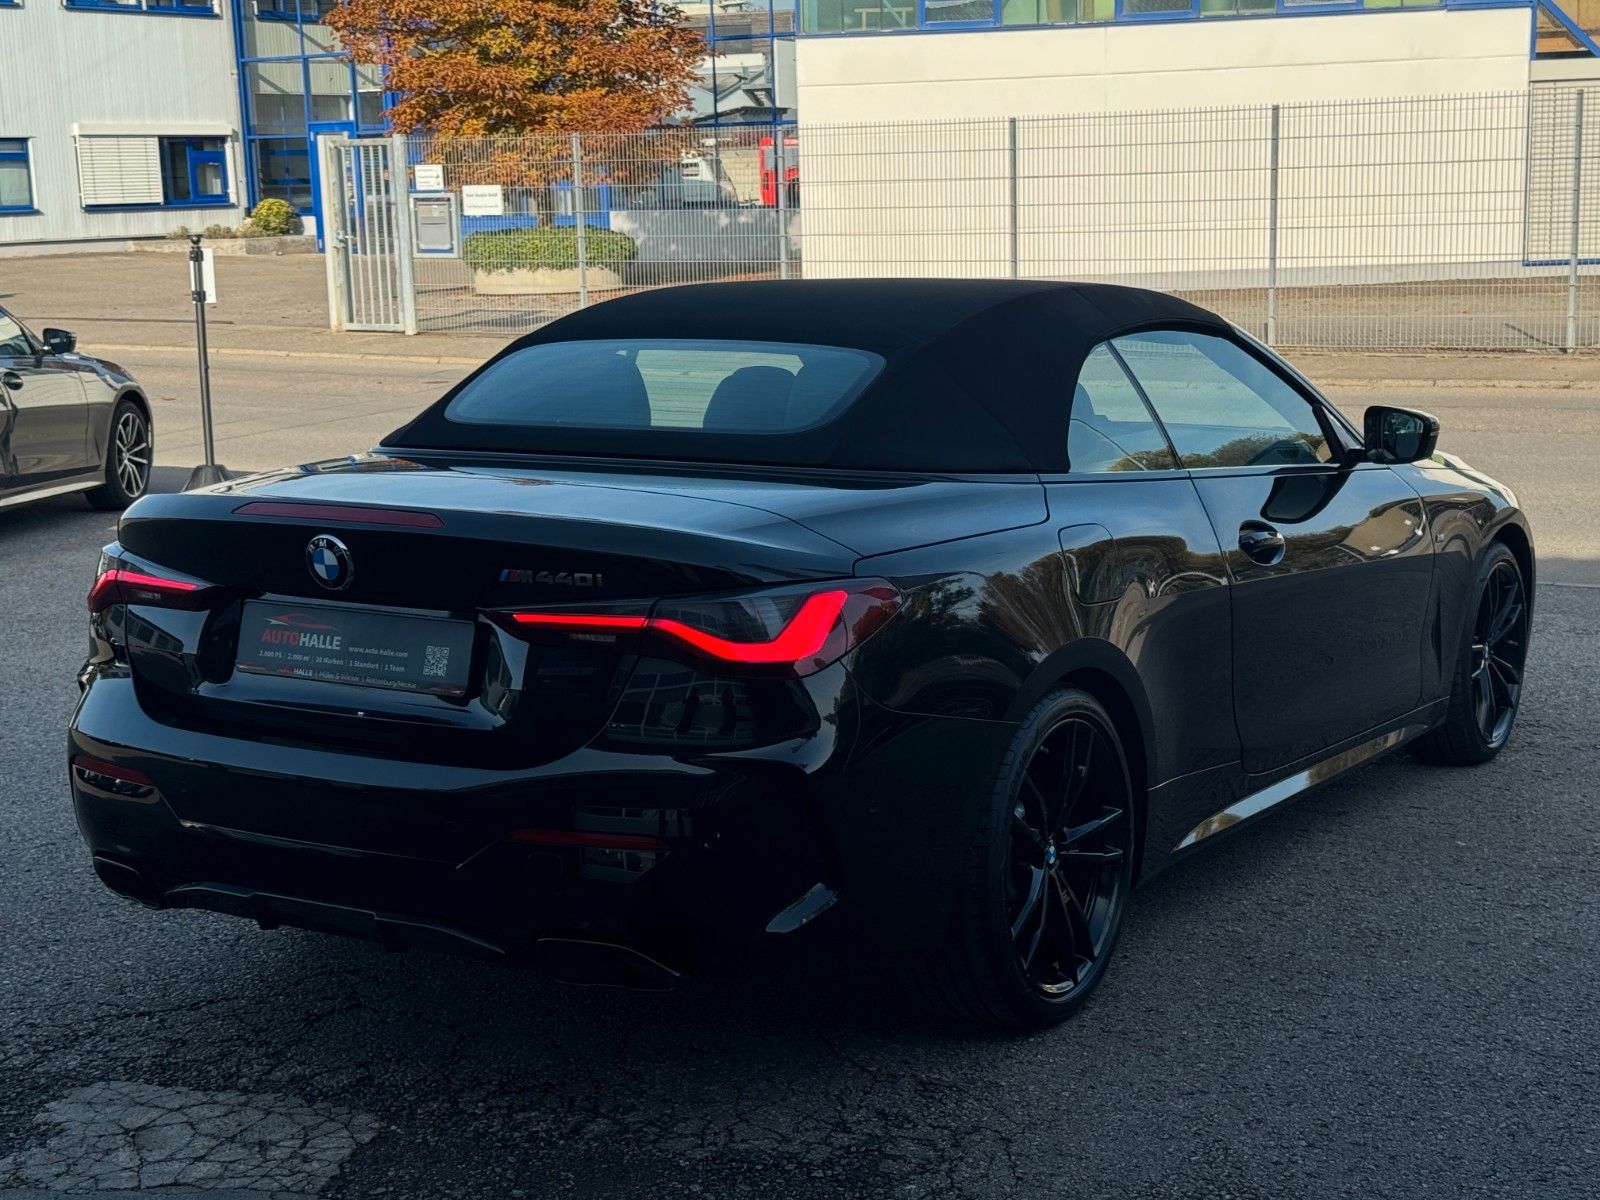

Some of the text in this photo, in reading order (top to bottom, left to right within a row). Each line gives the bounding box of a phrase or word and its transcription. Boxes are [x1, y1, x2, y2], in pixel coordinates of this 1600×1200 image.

[261, 628, 342, 650] AUTOHALLE
[354, 660, 379, 669] Standort
[389, 664, 405, 672] Team
